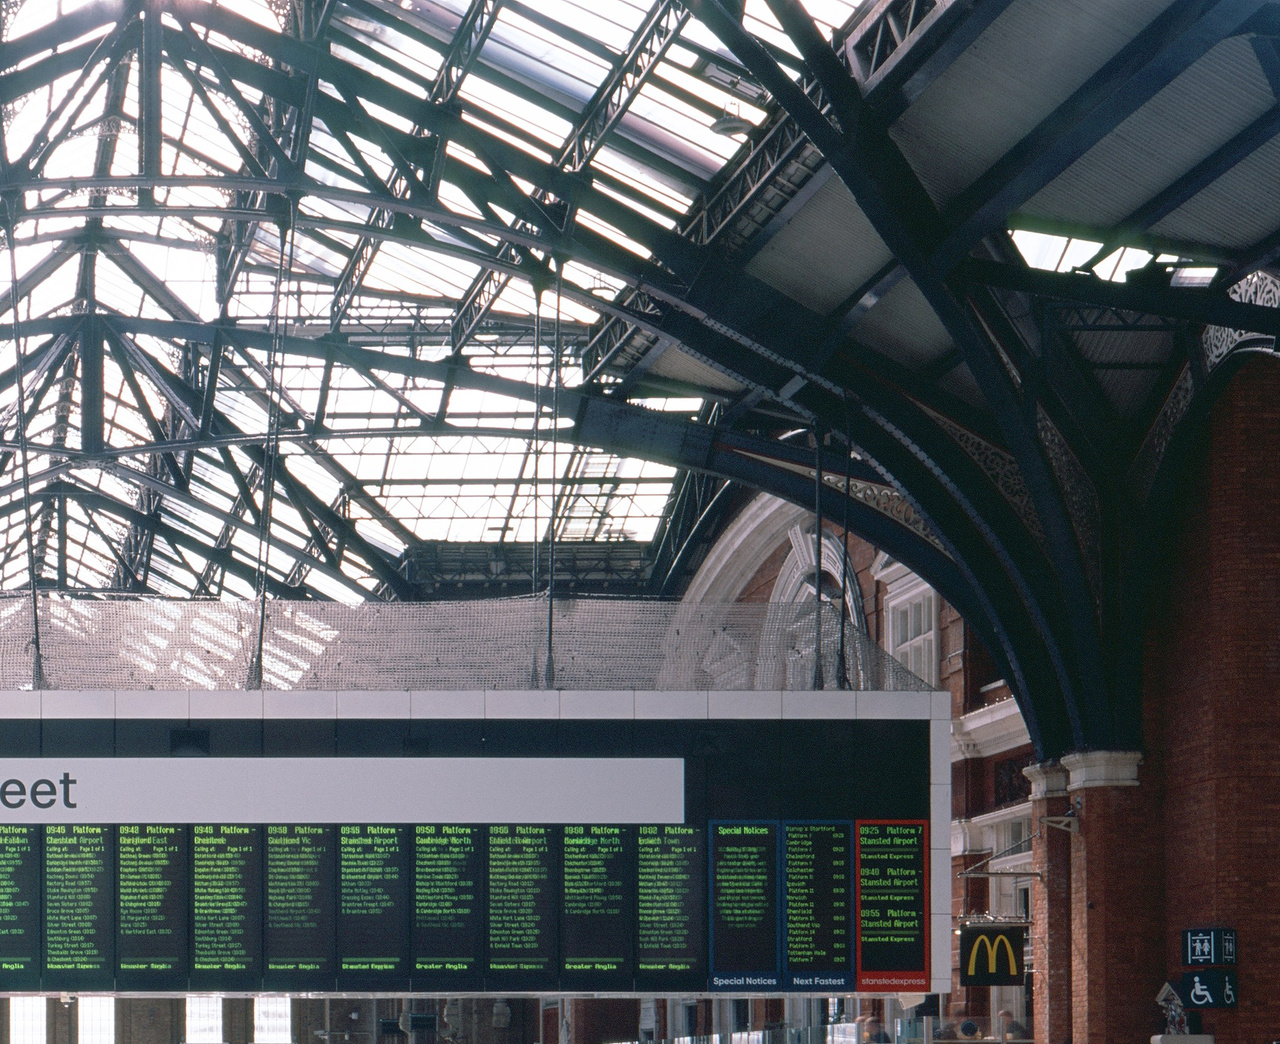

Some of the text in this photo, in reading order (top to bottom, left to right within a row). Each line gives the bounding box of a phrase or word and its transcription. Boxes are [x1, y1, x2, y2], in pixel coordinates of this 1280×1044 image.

[718, 826, 768, 835] Special Notices
[887, 826, 915, 834] Platform
[860, 837, 918, 846] Stansted Airport
[860, 878, 918, 887] Stansted Airport
[894, 920, 918, 928] Airport
[713, 977, 776, 987] Special Notices
[793, 977, 845, 985] Next Fastest
[861, 978, 926, 987] stanstedexpress
